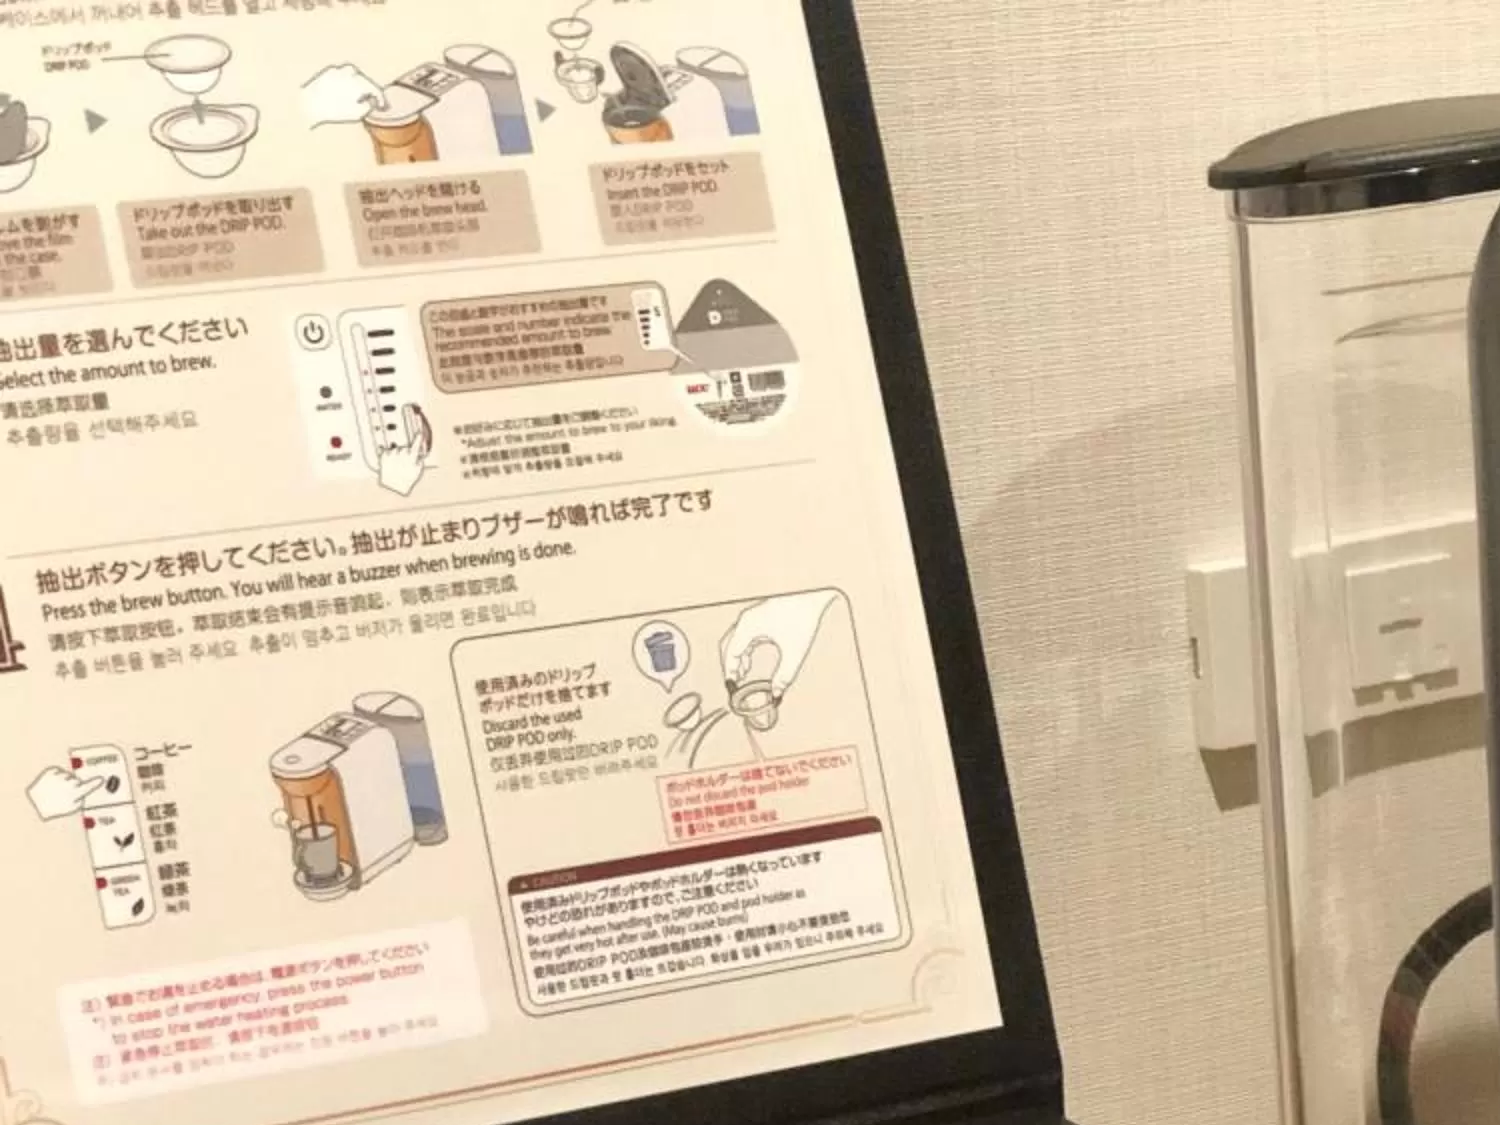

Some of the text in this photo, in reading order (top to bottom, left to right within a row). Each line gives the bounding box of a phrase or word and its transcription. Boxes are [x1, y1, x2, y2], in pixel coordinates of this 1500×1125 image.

[49, 366, 77, 385] the
[81, 361, 146, 381] amount
[149, 359, 167, 374] to
[170, 355, 217, 373] brew.
[41, 540, 577, 622] Press the brew button. You will hear a buzzer when brewing is done.
[482, 704, 582, 735] Discard the used
[134, 742, 192, 761] コーヒー
[485, 735, 514, 752] DRIP
[517, 730, 545, 746] POD
